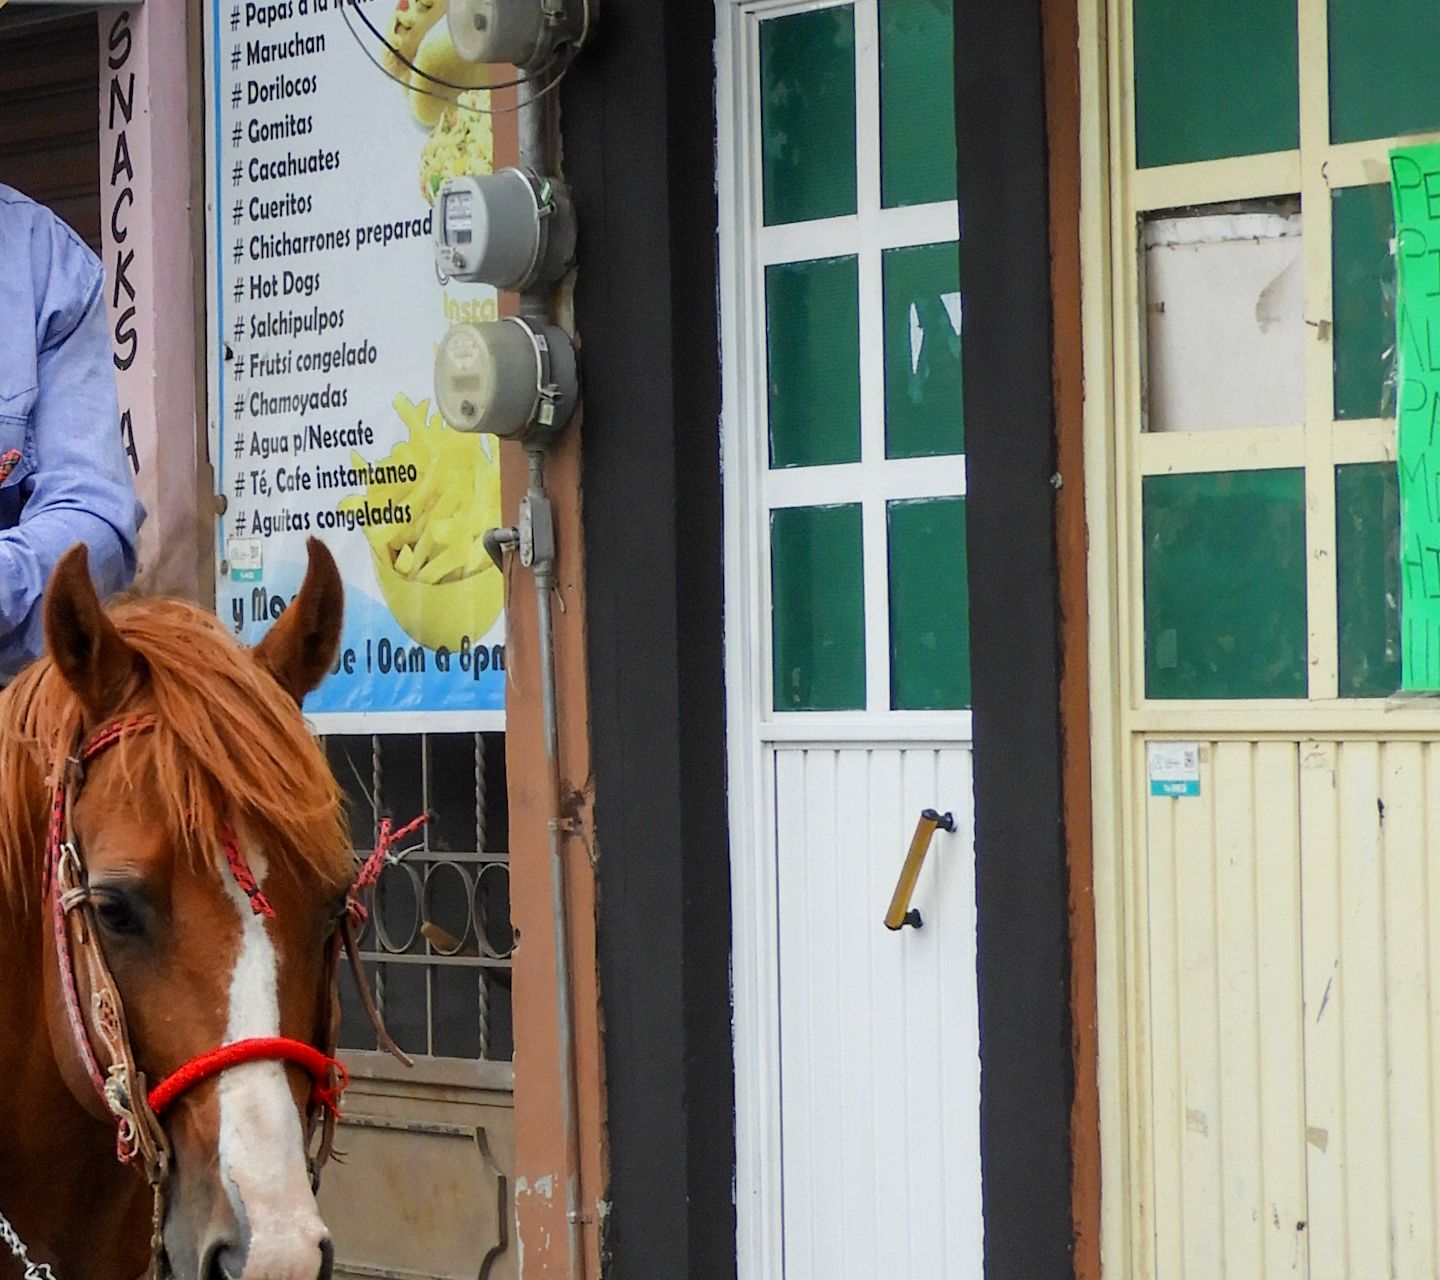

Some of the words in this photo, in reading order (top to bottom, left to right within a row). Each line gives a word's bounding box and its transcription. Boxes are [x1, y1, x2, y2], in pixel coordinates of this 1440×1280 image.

[245, 0, 294, 29] Papas
[246, 31, 326, 67] Maruchan
[247, 74, 317, 105] Dorilocos
[248, 113, 313, 144] Gomitas
[248, 148, 340, 183] Cacahuates
[108, 11, 138, 372] SNACKS
[248, 192, 312, 222] Cueritos
[249, 228, 350, 261] Chicharrones
[250, 274, 278, 300] Hot
[283, 270, 320, 297] Dogs
[250, 306, 344, 339] Salchipulpos
[250, 350, 292, 378] Frutsi
[296, 339, 377, 374] congelado
[249, 388, 348, 418] Chamoyadas
[249, 431, 289, 459] Agua
[316, 462, 417, 489] instantaneo
[251, 507, 311, 537] Aguitas
[316, 498, 412, 532] congeladas
[251, 586, 299, 622] Ma
